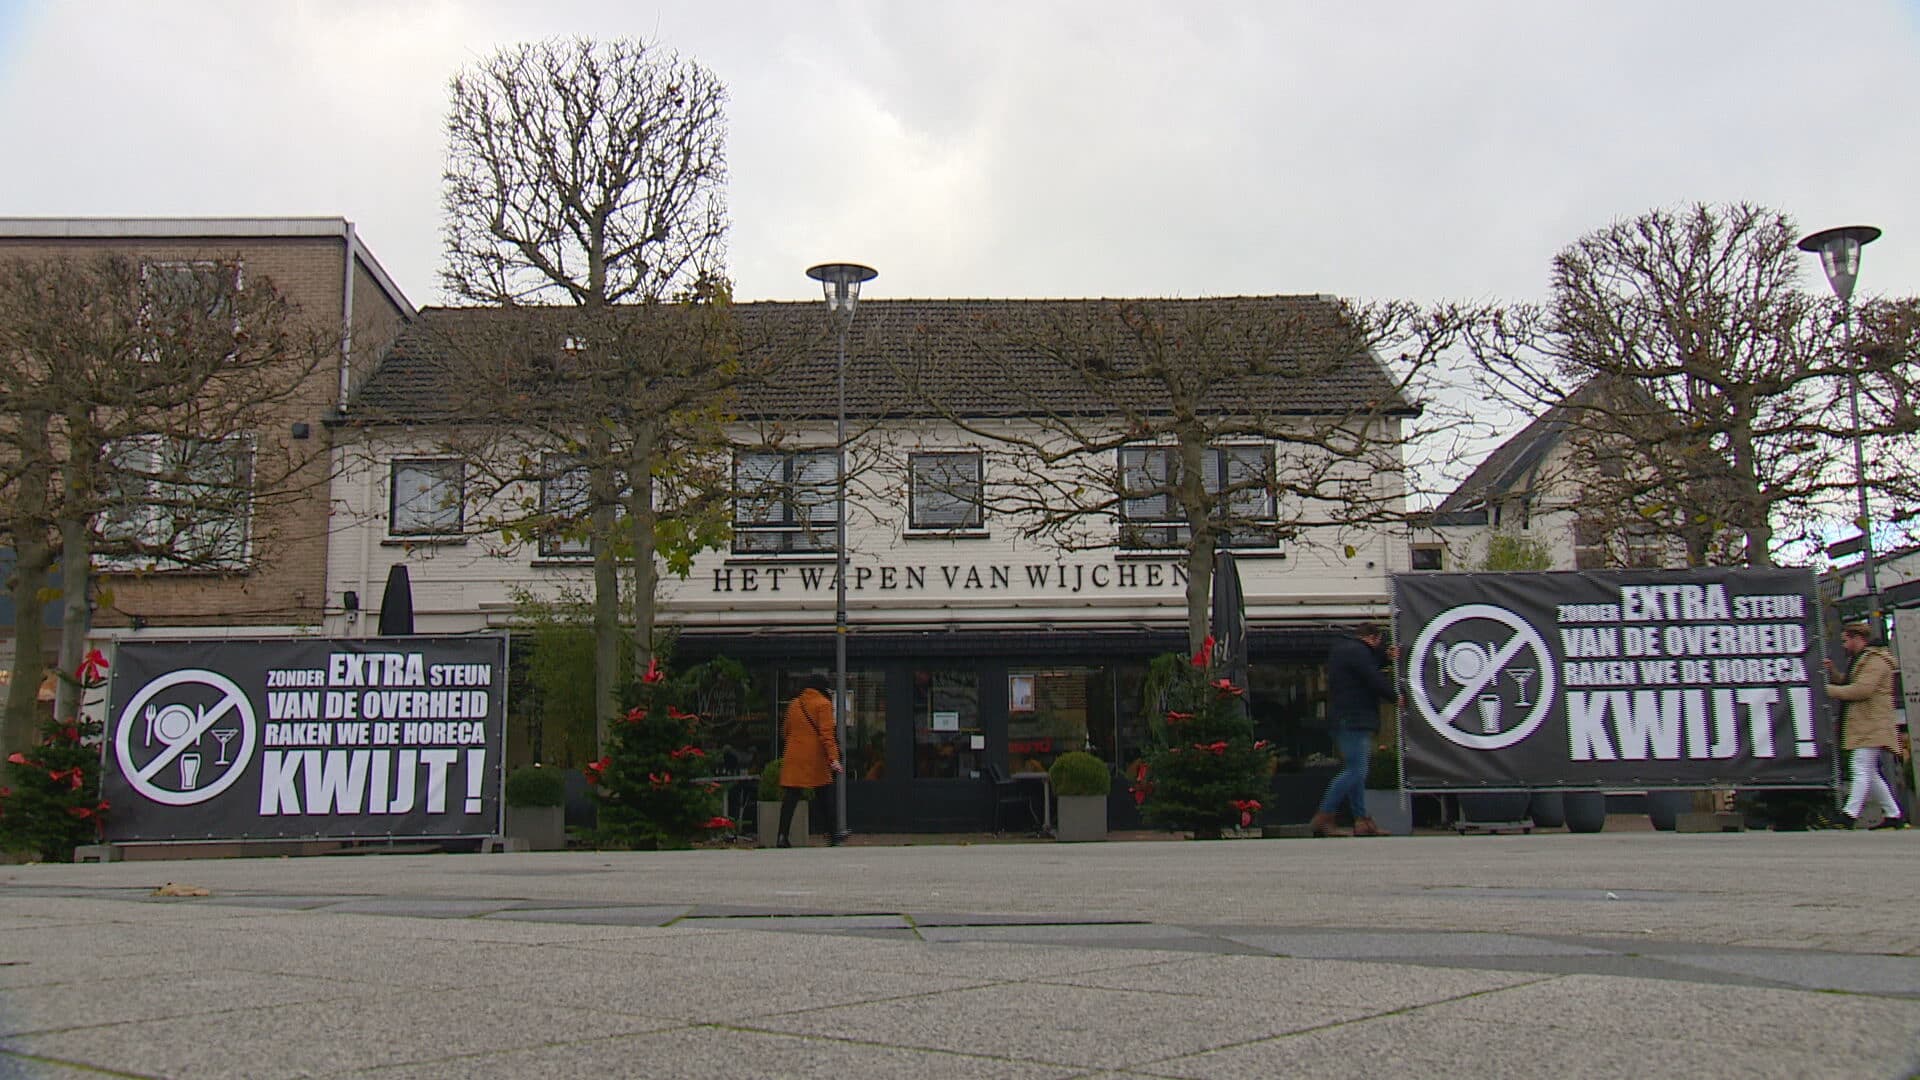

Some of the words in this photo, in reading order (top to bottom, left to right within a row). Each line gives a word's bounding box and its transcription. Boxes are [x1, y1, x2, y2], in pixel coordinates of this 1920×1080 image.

[713, 567, 786, 592] HET
[940, 564, 1011, 589] VAN
[1025, 563, 1190, 592] WIJCHEN
[1556, 604, 1620, 622] ZONDER
[1620, 585, 1731, 621] EXTRA
[1733, 595, 1807, 619] STEUN
[1560, 627, 1620, 658] VAN
[1623, 626, 1662, 657] DE
[1663, 623, 1808, 656] OVERHEID
[267, 669, 325, 688] ZONDER
[328, 652, 426, 687] EXTRA
[430, 664, 491, 686] STEUN
[1562, 659, 1640, 686] RAKEN
[1639, 658, 1681, 684] WE
[1679, 657, 1713, 684] DE
[1712, 655, 1809, 683] HORECA
[267, 691, 320, 720] VAN
[325, 690, 358, 719] DE
[362, 690, 489, 720] OVERHEID
[264, 722, 333, 746] RAKEN
[335, 722, 370, 746] WE
[373, 722, 400, 745] DE
[402, 721, 487, 745] HORECA
